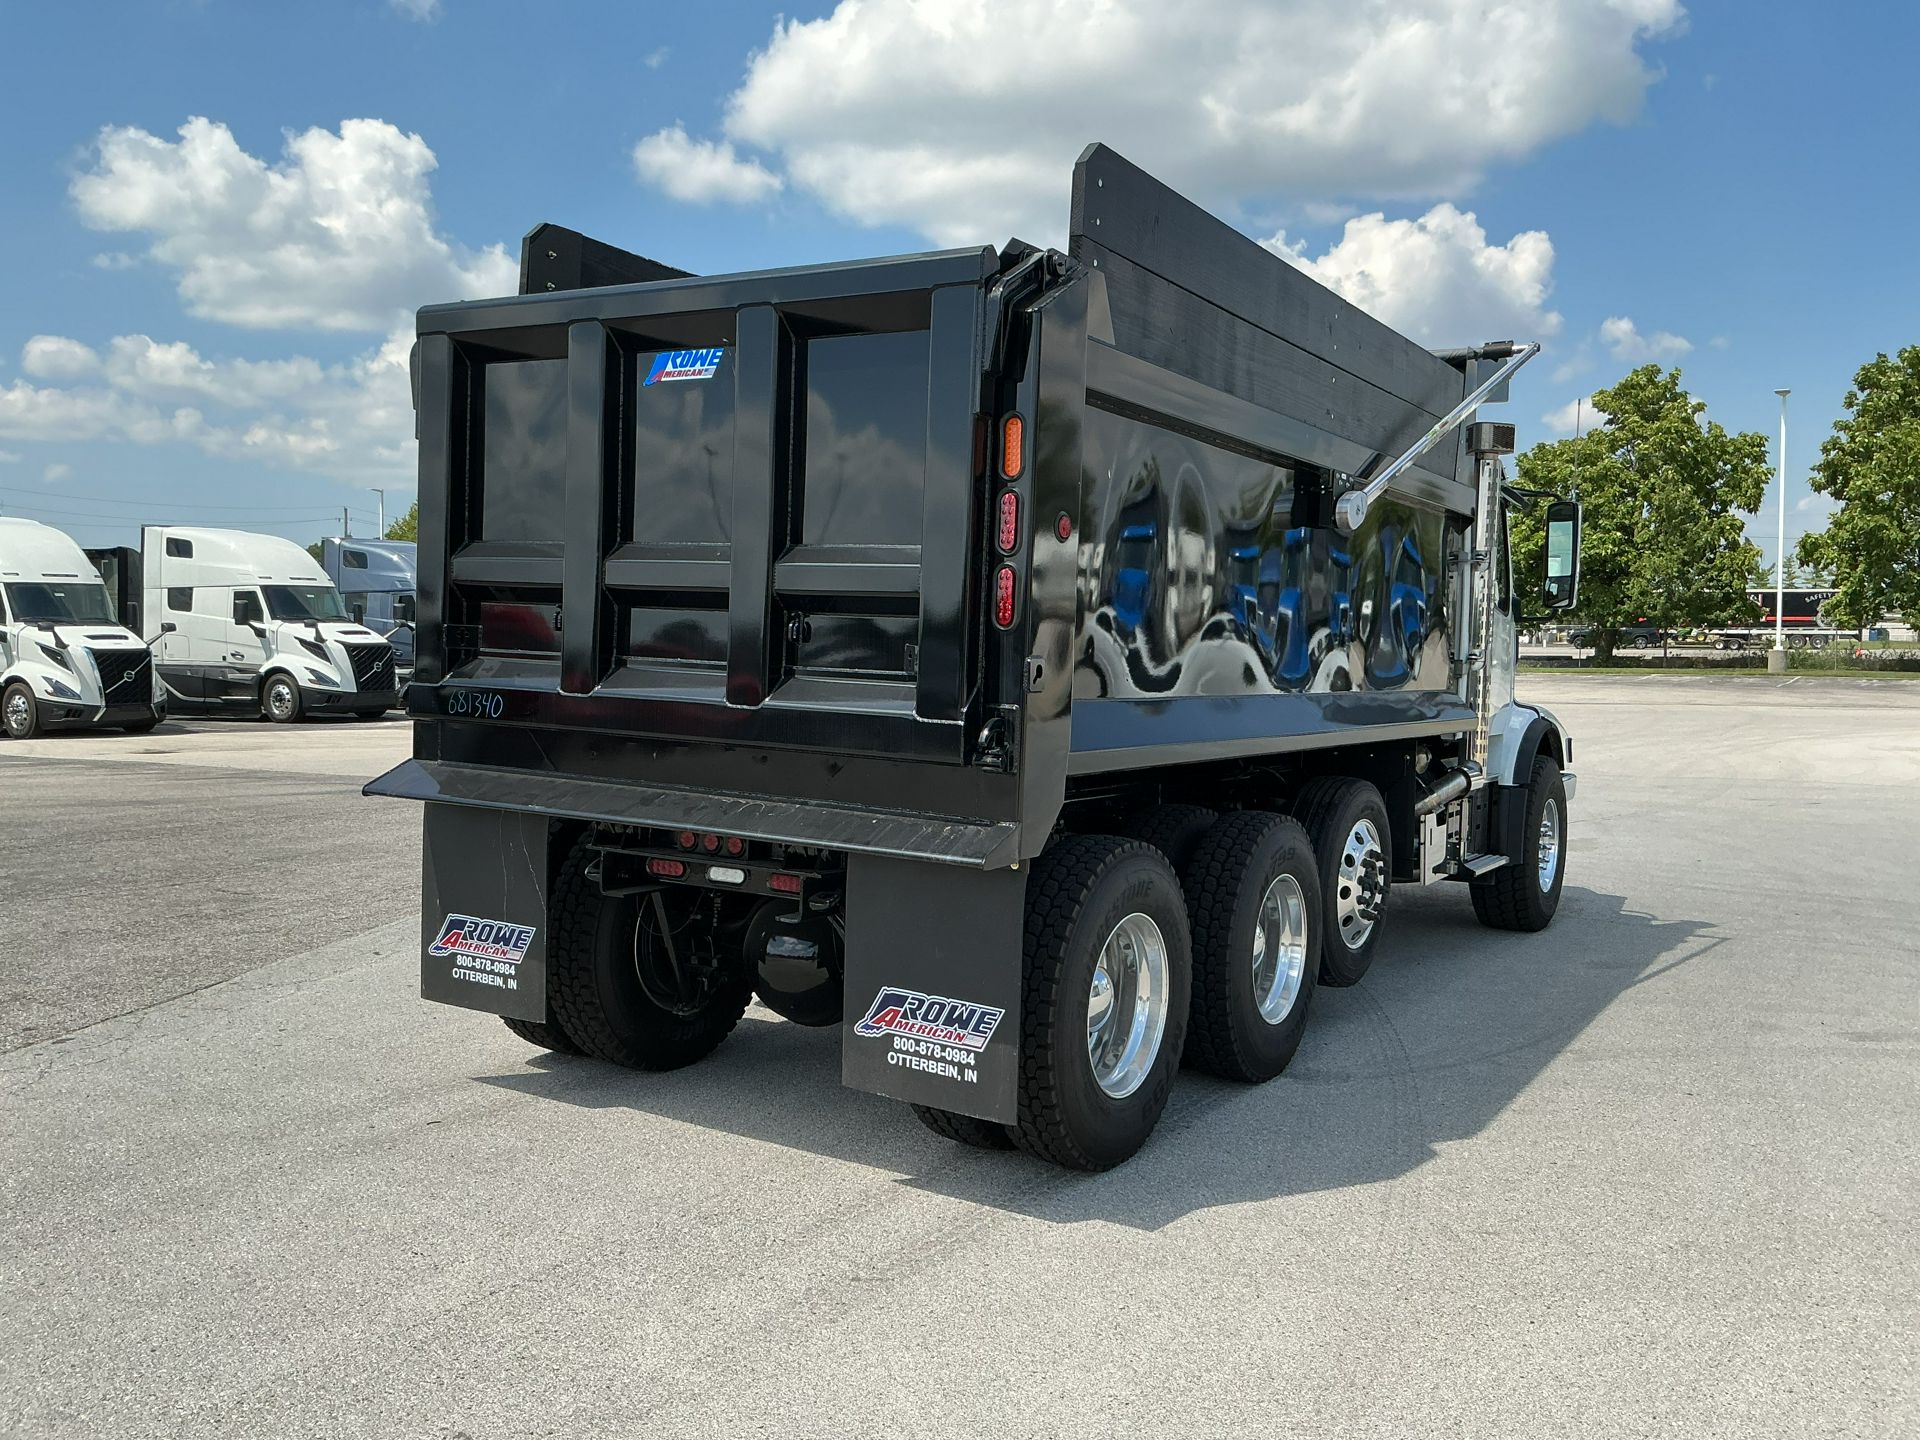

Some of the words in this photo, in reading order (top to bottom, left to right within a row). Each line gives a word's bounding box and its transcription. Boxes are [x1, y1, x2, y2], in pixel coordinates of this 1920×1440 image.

[669, 348, 724, 369] ROWE
[650, 368, 705, 381] AMERICAN
[1804, 592, 1832, 603] SAFETY
[448, 689, 503, 718] 681340
[440, 930, 509, 957] AMERICAN
[461, 920, 532, 950] ROWE
[452, 967, 506, 989] OTTERBEIN,
[507, 978, 518, 990] IN
[456, 954, 516, 976] 800-878-0984
[870, 1006, 968, 1044] AMERICAN
[900, 996, 1000, 1036] ROWE
[893, 1036, 976, 1066] 800-878-0984
[887, 1051, 962, 1081] OTTERBEIN,
[964, 1068, 978, 1083] IN
